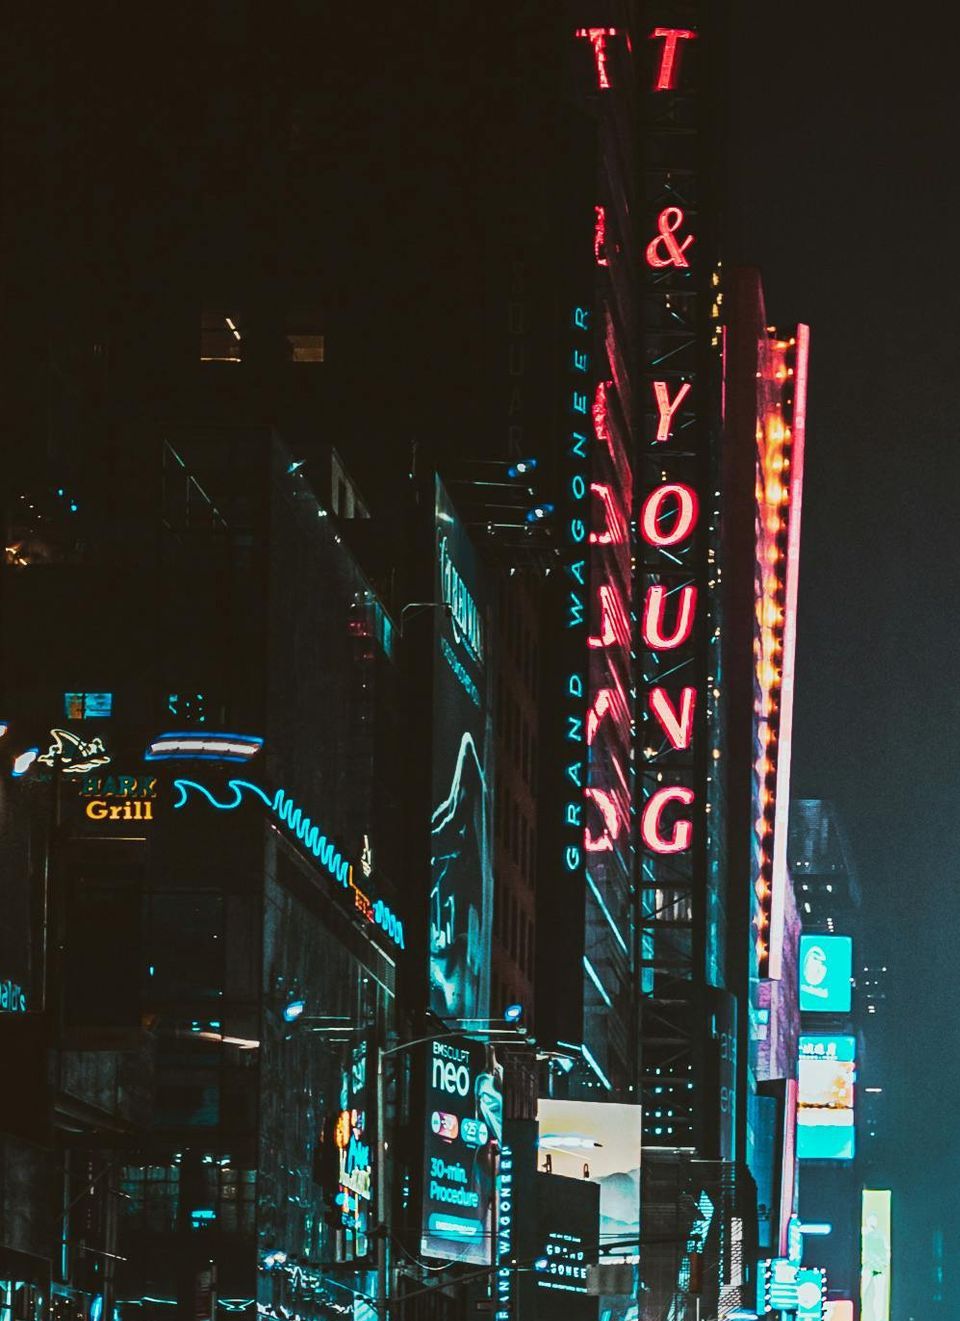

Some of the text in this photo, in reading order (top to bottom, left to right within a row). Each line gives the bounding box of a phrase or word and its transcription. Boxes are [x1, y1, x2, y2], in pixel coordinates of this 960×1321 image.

[565, 305, 590, 871] GRAND WAGONEER
[86, 800, 153, 820] Grill
[432, 1058, 470, 1096] neo
[430, 1157, 467, 1184] 30-min.
[430, 1180, 479, 1208] Procedure
